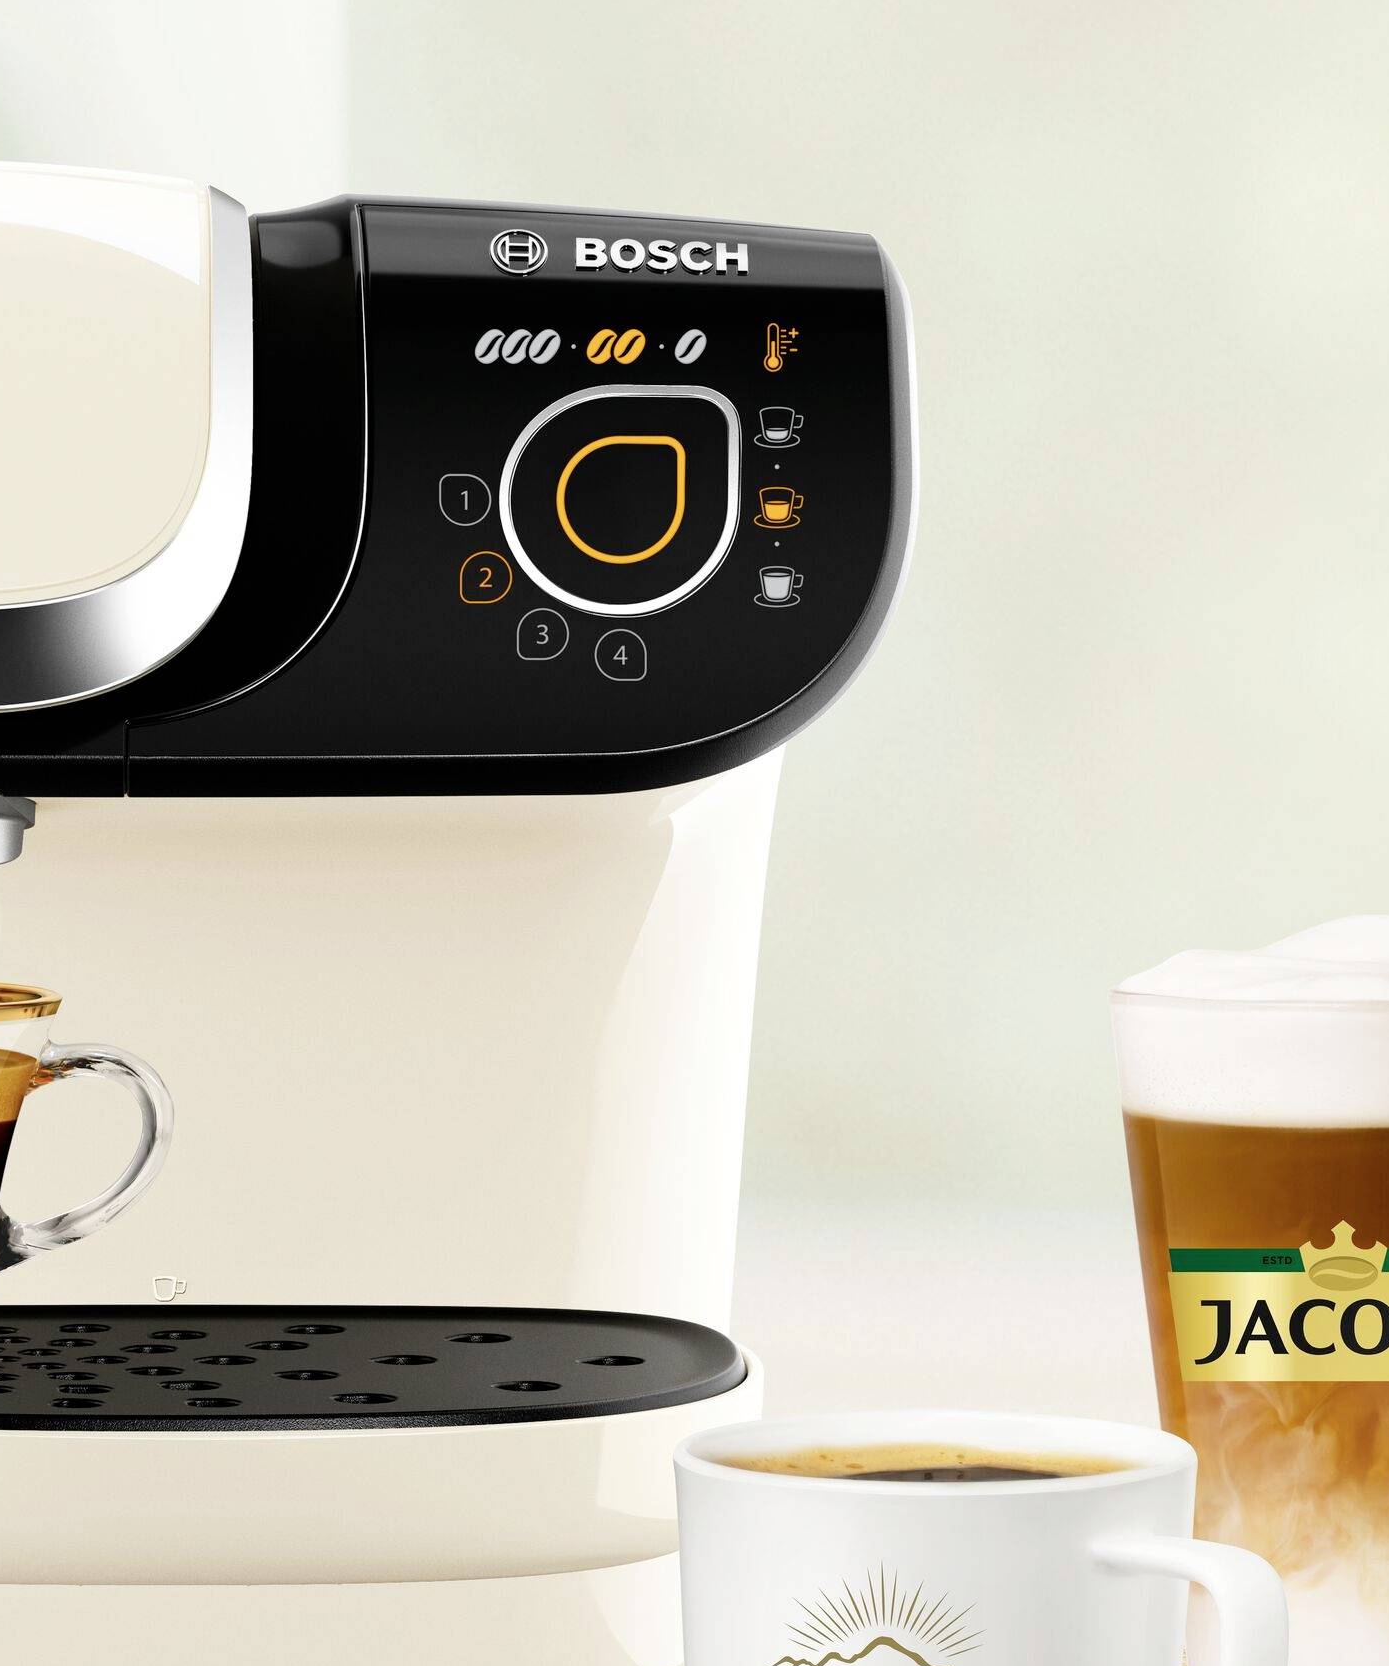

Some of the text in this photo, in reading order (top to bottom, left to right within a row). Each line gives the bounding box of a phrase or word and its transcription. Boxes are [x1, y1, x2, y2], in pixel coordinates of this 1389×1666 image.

[575, 236, 750, 276] BOSCH
[460, 490, 470, 510] 1
[478, 568, 493, 588] 2
[535, 625, 550, 645] 3
[612, 645, 629, 666] 4
[1262, 1256, 1293, 1265] ESTD
